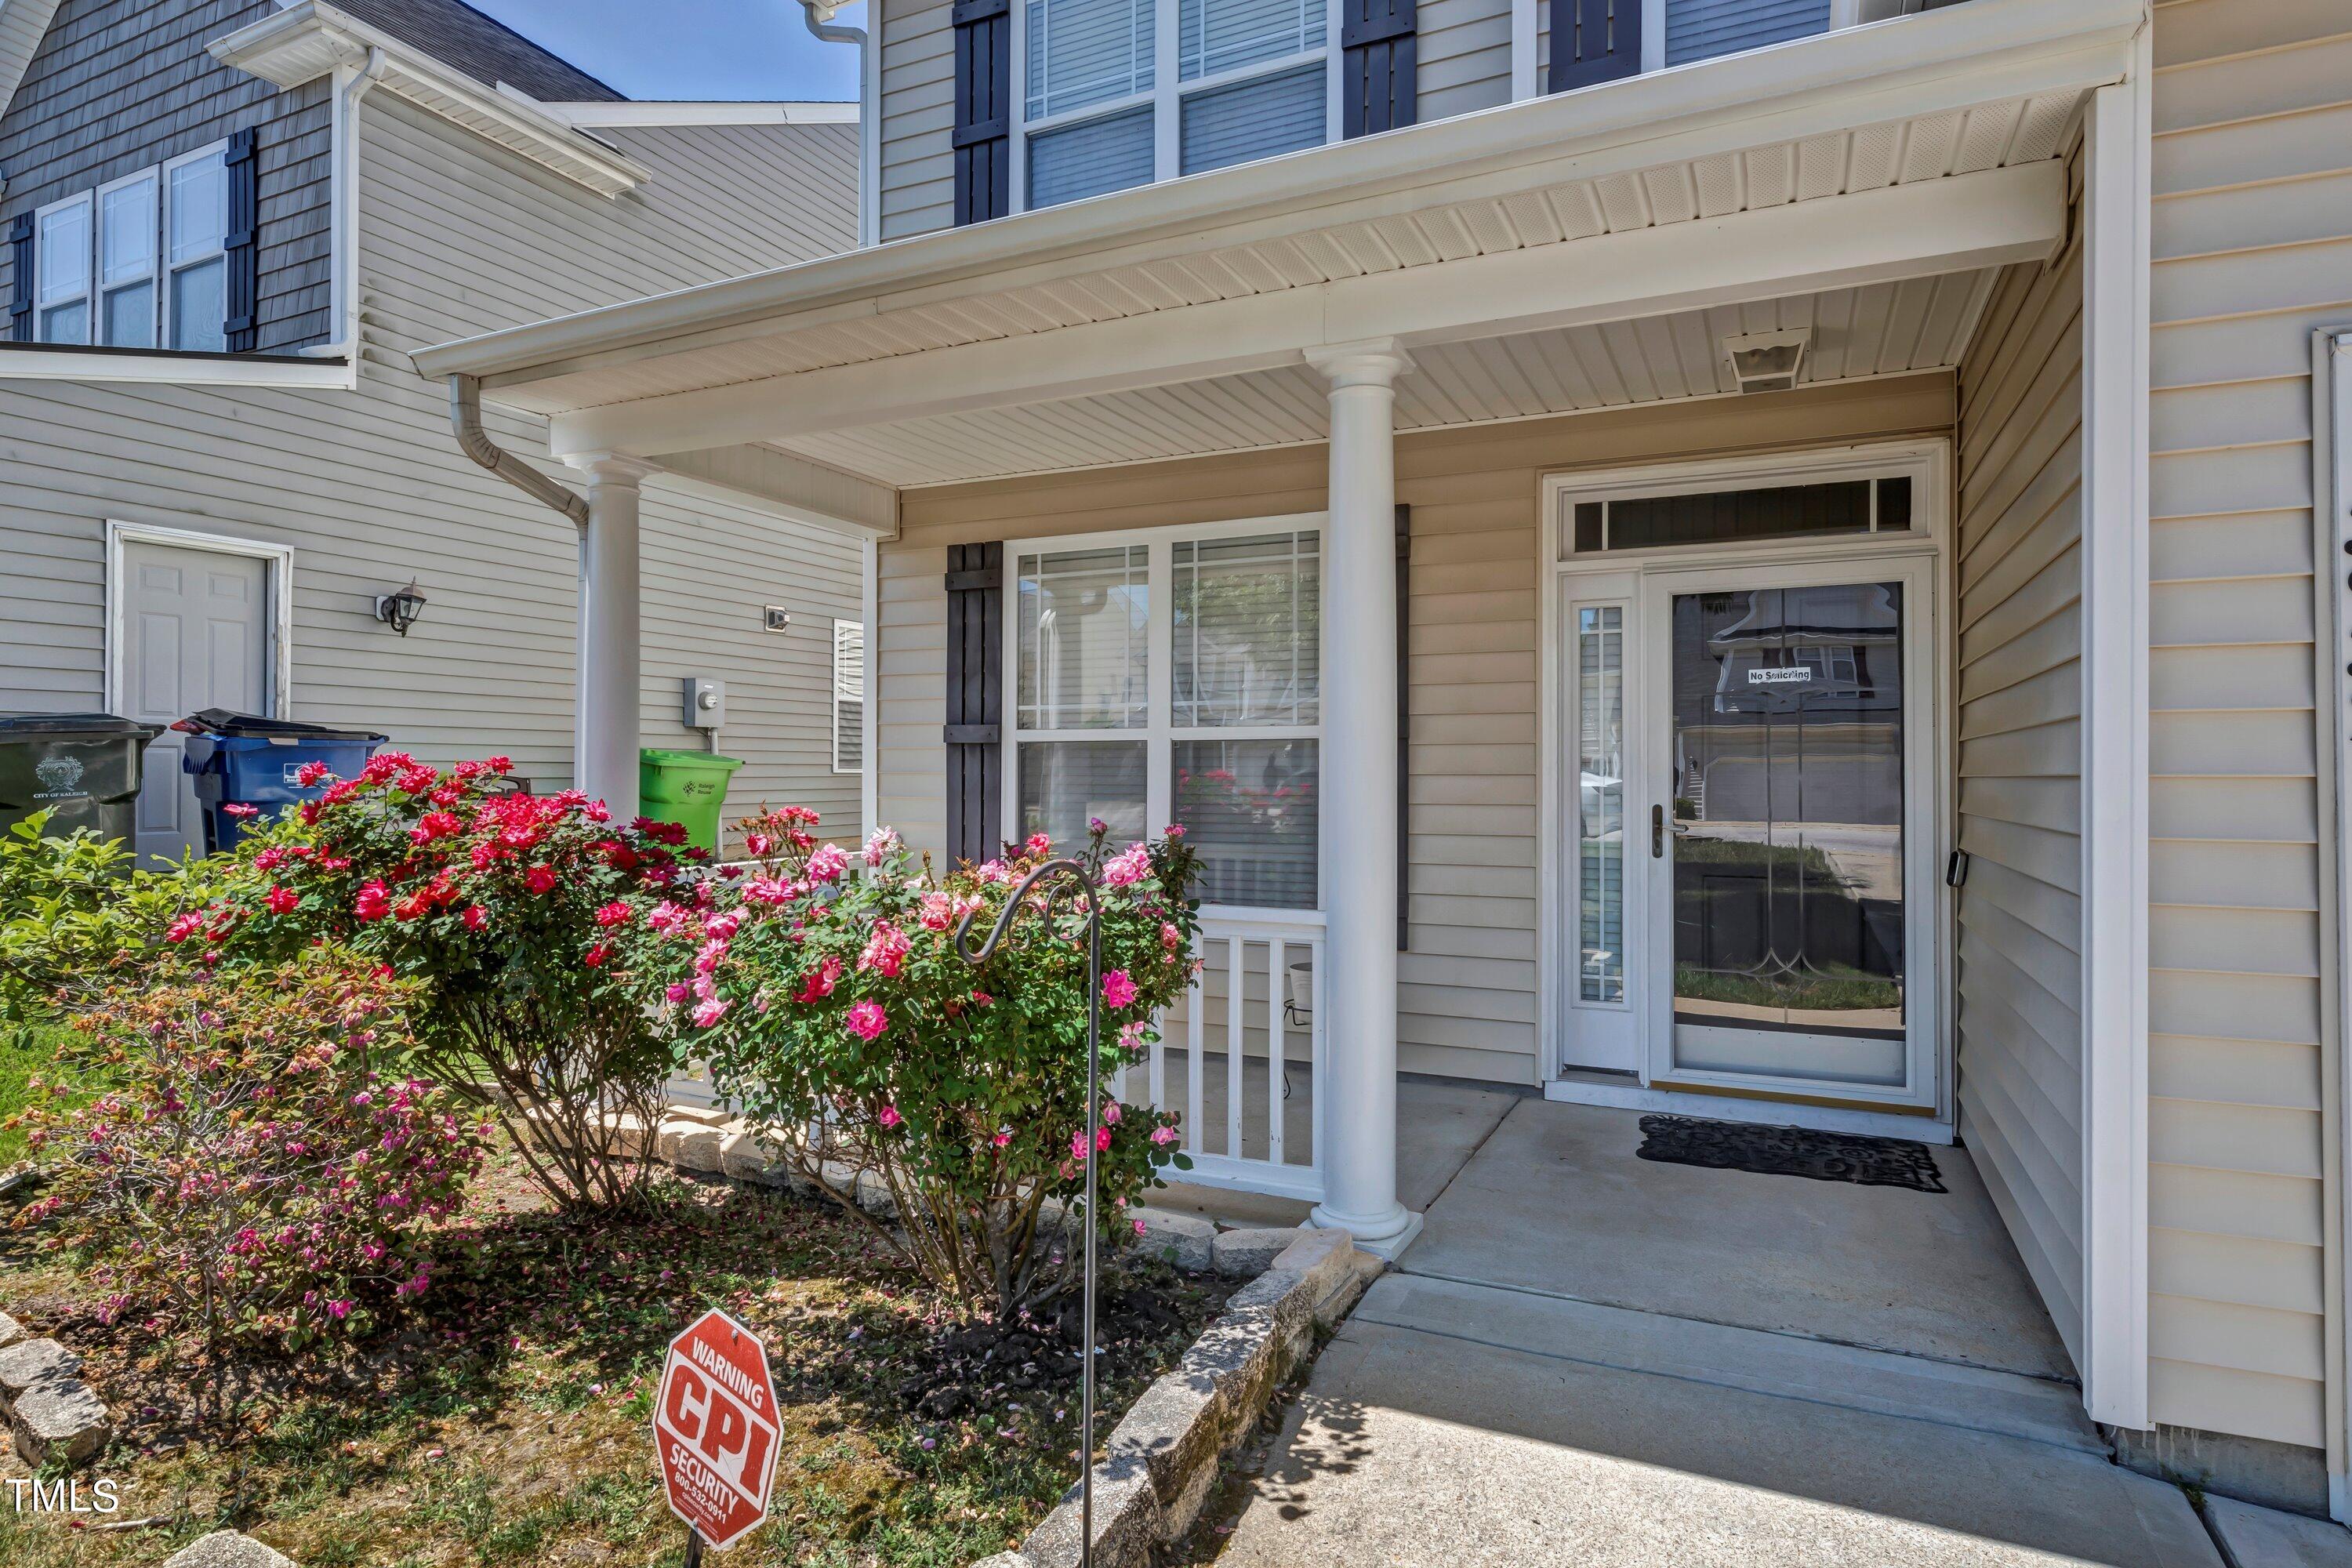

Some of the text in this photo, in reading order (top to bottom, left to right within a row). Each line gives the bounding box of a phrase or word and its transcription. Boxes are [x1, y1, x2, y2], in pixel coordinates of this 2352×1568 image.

[1751, 672, 1762, 681] No
[692, 1336, 764, 1410] WARNING
[666, 1364, 771, 1499] CPI
[670, 1443, 740, 1515] SECURITY
[675, 1472, 727, 1524] 800-532-0911
[681, 1492, 714, 1523] cpisecurity.com
